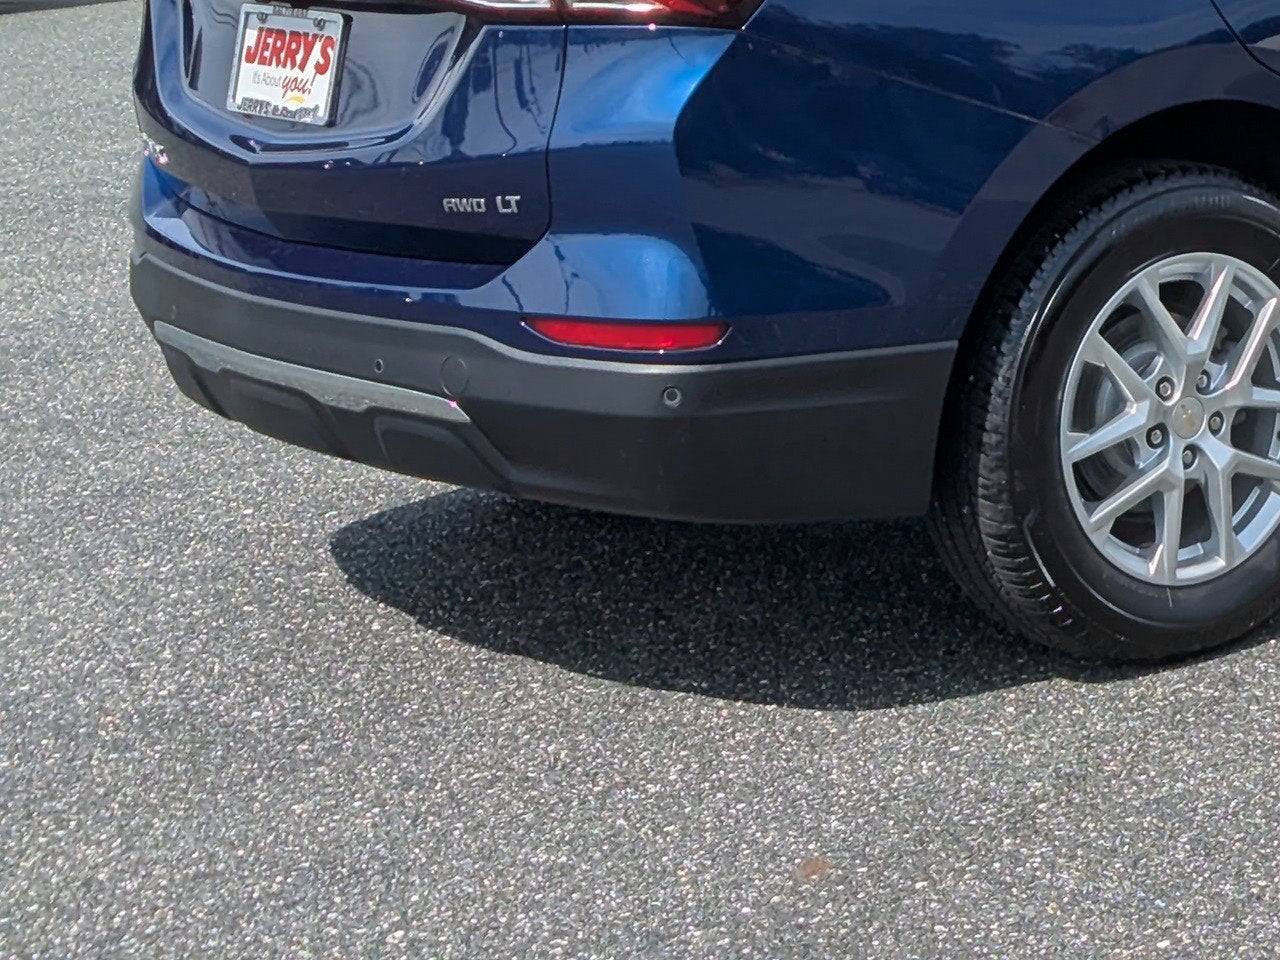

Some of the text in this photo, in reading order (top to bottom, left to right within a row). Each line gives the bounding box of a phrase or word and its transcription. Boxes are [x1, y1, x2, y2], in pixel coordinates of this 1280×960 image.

[244, 26, 335, 76] JERRY'S
[261, 72, 282, 88] About
[281, 72, 318, 99] you!
[442, 195, 521, 213] AWD LT
